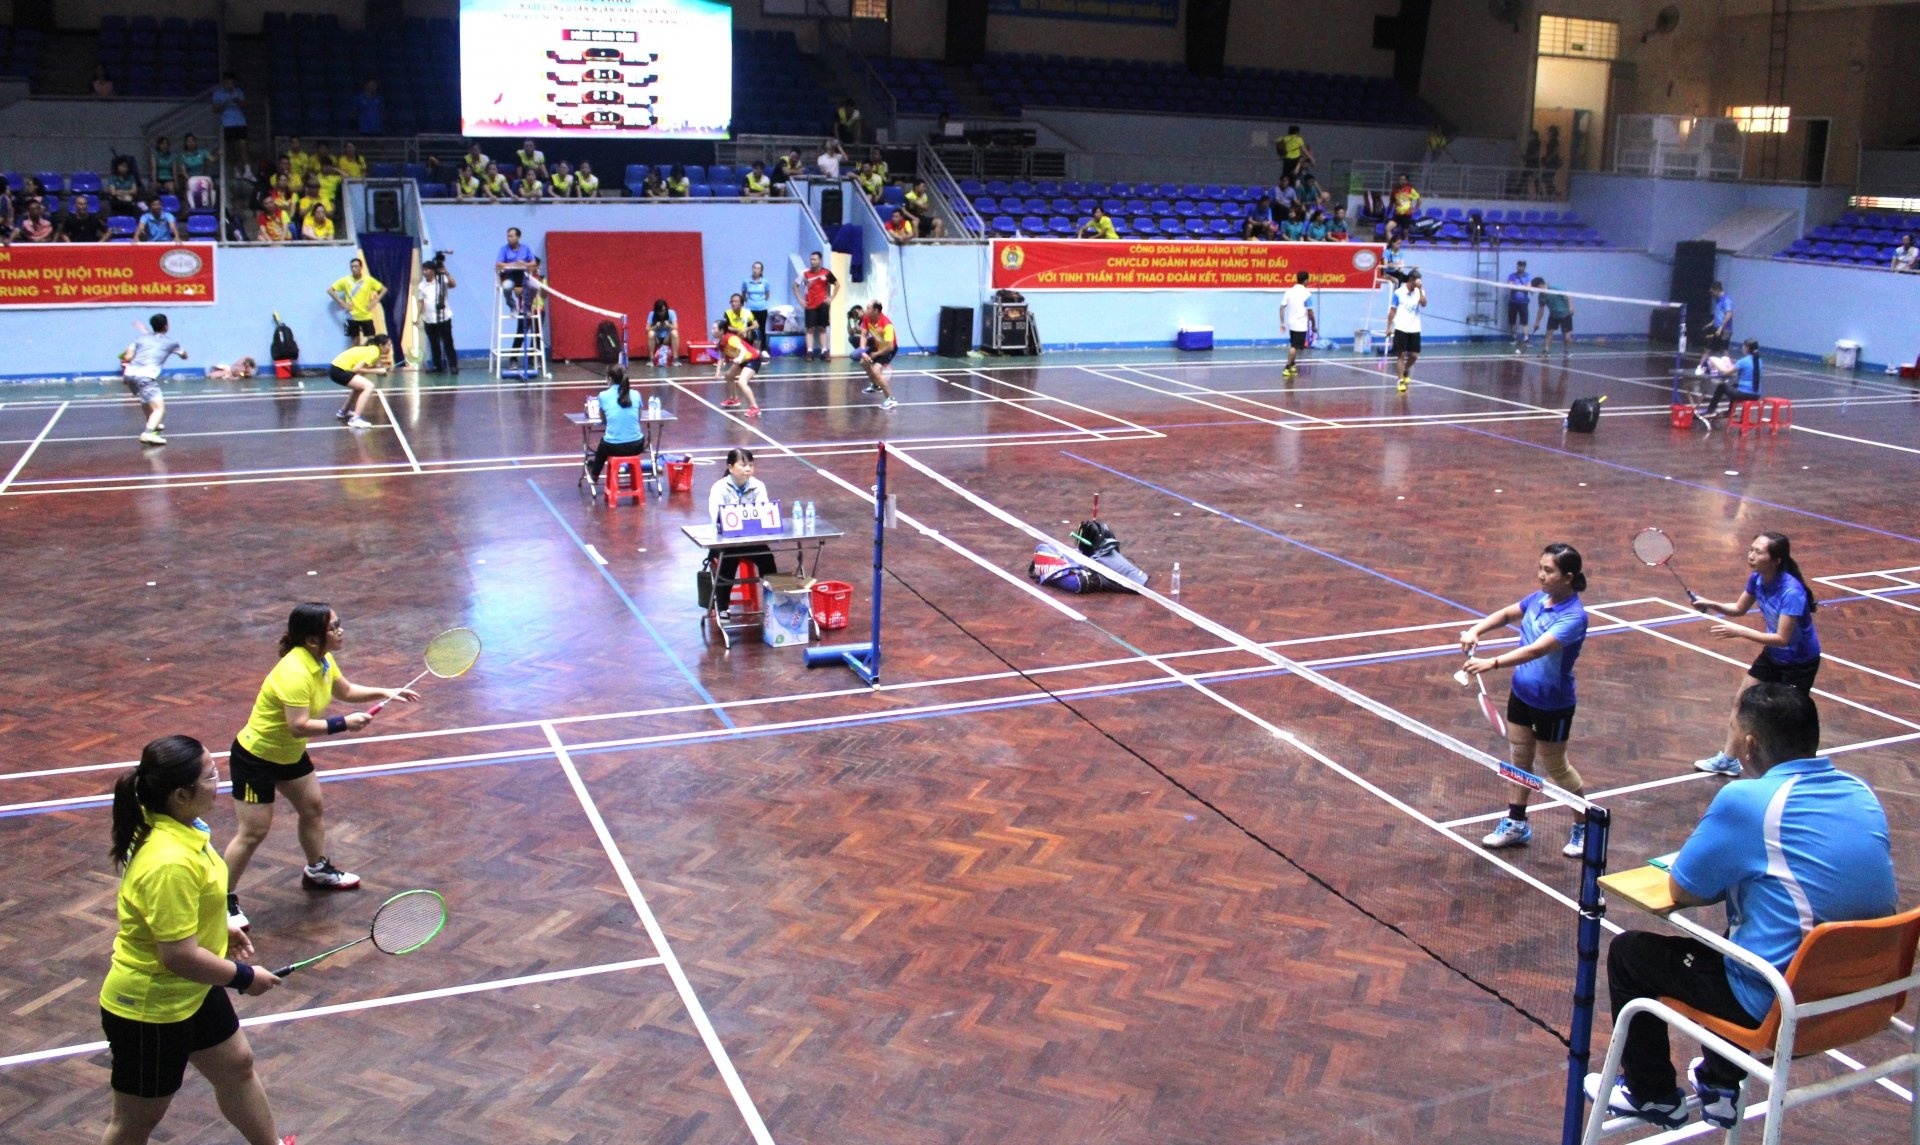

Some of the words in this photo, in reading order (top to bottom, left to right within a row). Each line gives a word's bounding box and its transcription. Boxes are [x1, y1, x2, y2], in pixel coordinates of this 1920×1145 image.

[1129, 245, 1155, 254] CÔNG
[1157, 245, 1181, 254] ĐOÀN
[1183, 246, 1206, 254] NGÂN
[1208, 246, 1231, 254] HÀNG
[1232, 246, 1248, 256] VIỆT
[1250, 247, 1268, 255] NAM
[1107, 257, 1149, 267] CNVCLĐ
[1152, 257, 1187, 267] NGÀNH
[1190, 257, 1219, 268] NGÂN
[1221, 257, 1249, 268] HÀNG
[1251, 258, 1265, 268] THI
[1268, 256, 1288, 268] ĐẤU
[0, 268, 39, 279] THAM
[42, 267, 65, 282] DỰ
[66, 265, 91, 282] HỘI
[94, 267, 134, 279] THAO
[1037, 270, 1056, 283] VỚI
[1060, 273, 1083, 282] TINH
[1116, 269, 1135, 282] THỂ
[1136, 273, 1164, 282] THAO
[1167, 272, 1197, 283] ĐOÀN
[1221, 273, 1252, 283] TRUNG
[52, 282, 79, 297] TÂY
[81, 282, 138, 296] NGUYÊN
[141, 281, 172, 295] NĂM
[726, 512, 738, 528] 0
[767, 510, 775, 526] 1
